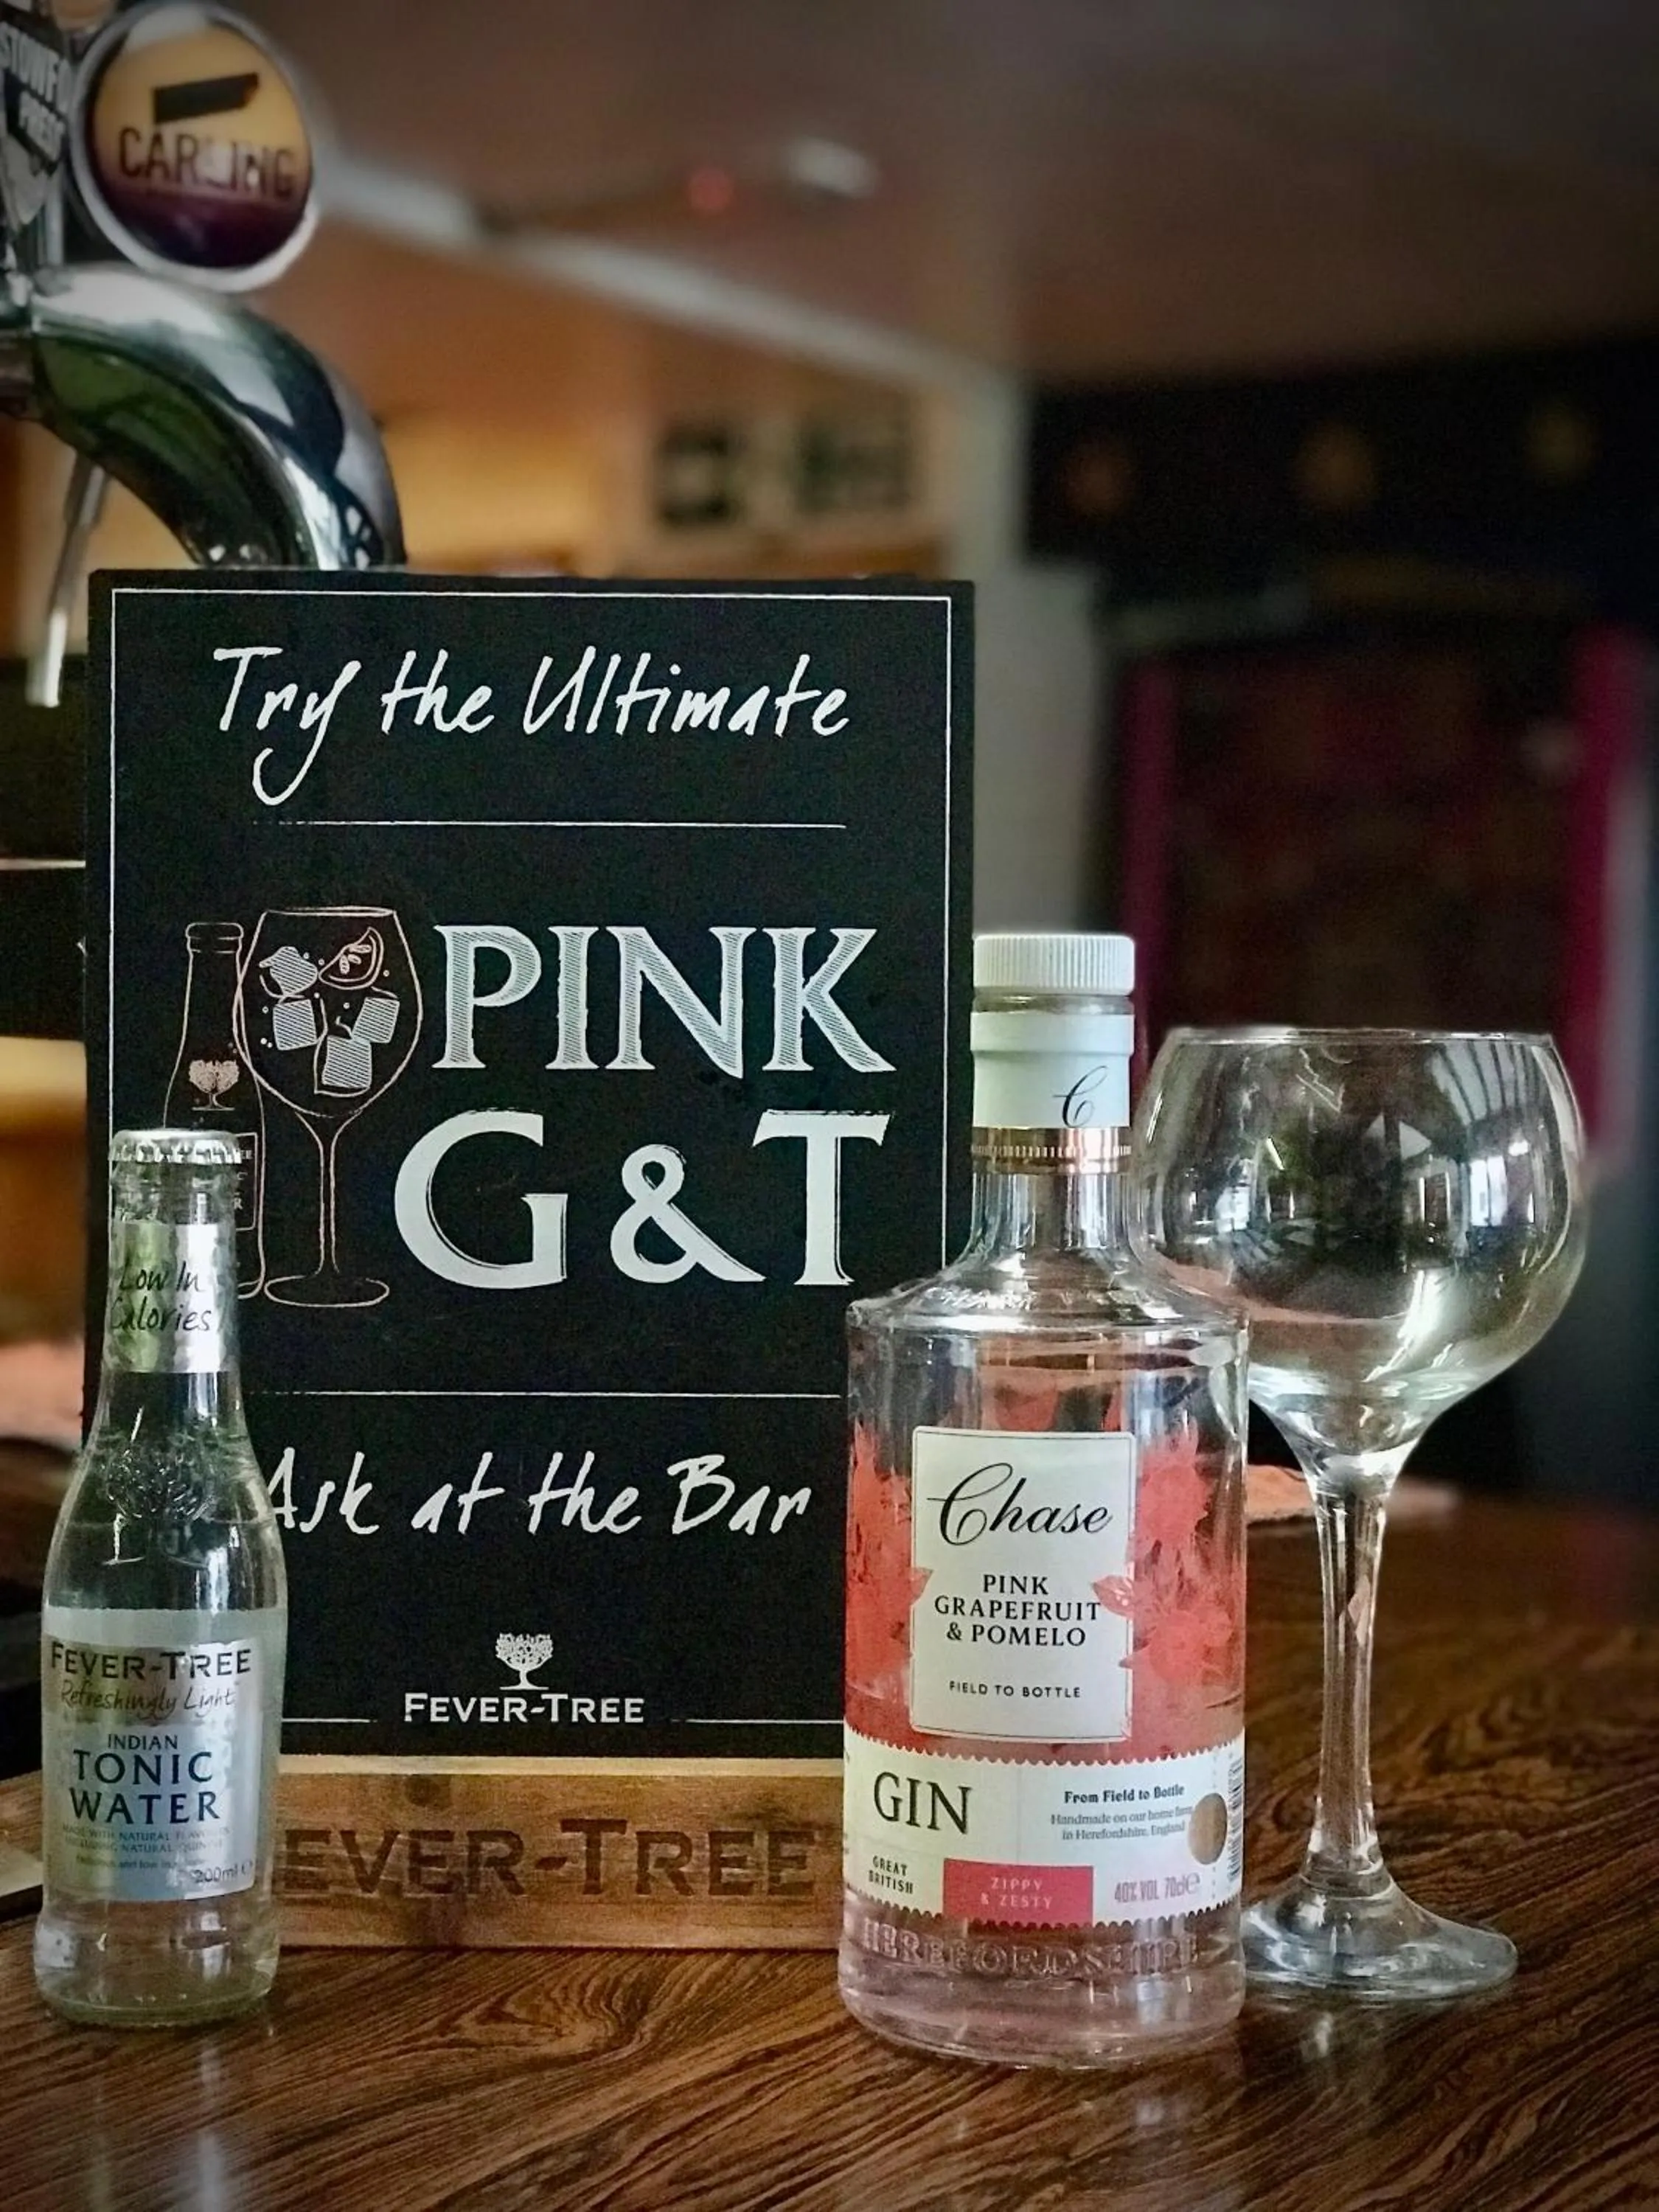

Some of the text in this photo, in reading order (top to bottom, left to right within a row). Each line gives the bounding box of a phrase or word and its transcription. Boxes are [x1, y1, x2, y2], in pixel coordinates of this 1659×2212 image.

[213, 645, 849, 805] Try the Ultimate
[431, 925, 897, 1079] PINK
[119, 1253, 170, 1291] Low
[110, 1295, 212, 1331] Calories
[267, 1447, 812, 1535] Ask at the Bar
[927, 1462, 1113, 1546] Chase
[982, 1574, 1048, 1596] PINK
[933, 1595, 1102, 1621] GRAPEFRUIT
[945, 1621, 1086, 1647] & POMELO
[50, 1640, 251, 1680] FEVER-TREE
[184, 1686, 236, 1718] Light
[949, 1680, 1081, 1699] FIELD TO BOTTLE
[404, 1692, 645, 1723] FEVER-TREE
[108, 1733, 178, 1750] INDIAN
[73, 1749, 213, 1785] TONIC
[69, 1787, 221, 1825] WATER
[874, 1771, 973, 1834] GIN
[1064, 1784, 1185, 1804] From Field to Bottle
[1051, 1811, 1111, 1825] Handmade
[1113, 1813, 1127, 1823] on
[1130, 1812, 1147, 1822] our
[1151, 1820, 1186, 1837] England
[119, 1832, 170, 1842] NATURAL
[122, 1843, 173, 1854] NATURAL
[285, 1818, 815, 1897] EVER-TREE
[872, 1854, 908, 1877] GREAT
[868, 1869, 914, 1894] BRITISH
[991, 1877, 1043, 1891] ZIPPY
[1114, 1881, 1138, 1904] 40%
[1138, 1879, 1159, 1902] VOL
[1000, 1894, 1053, 1910] ZESTY
